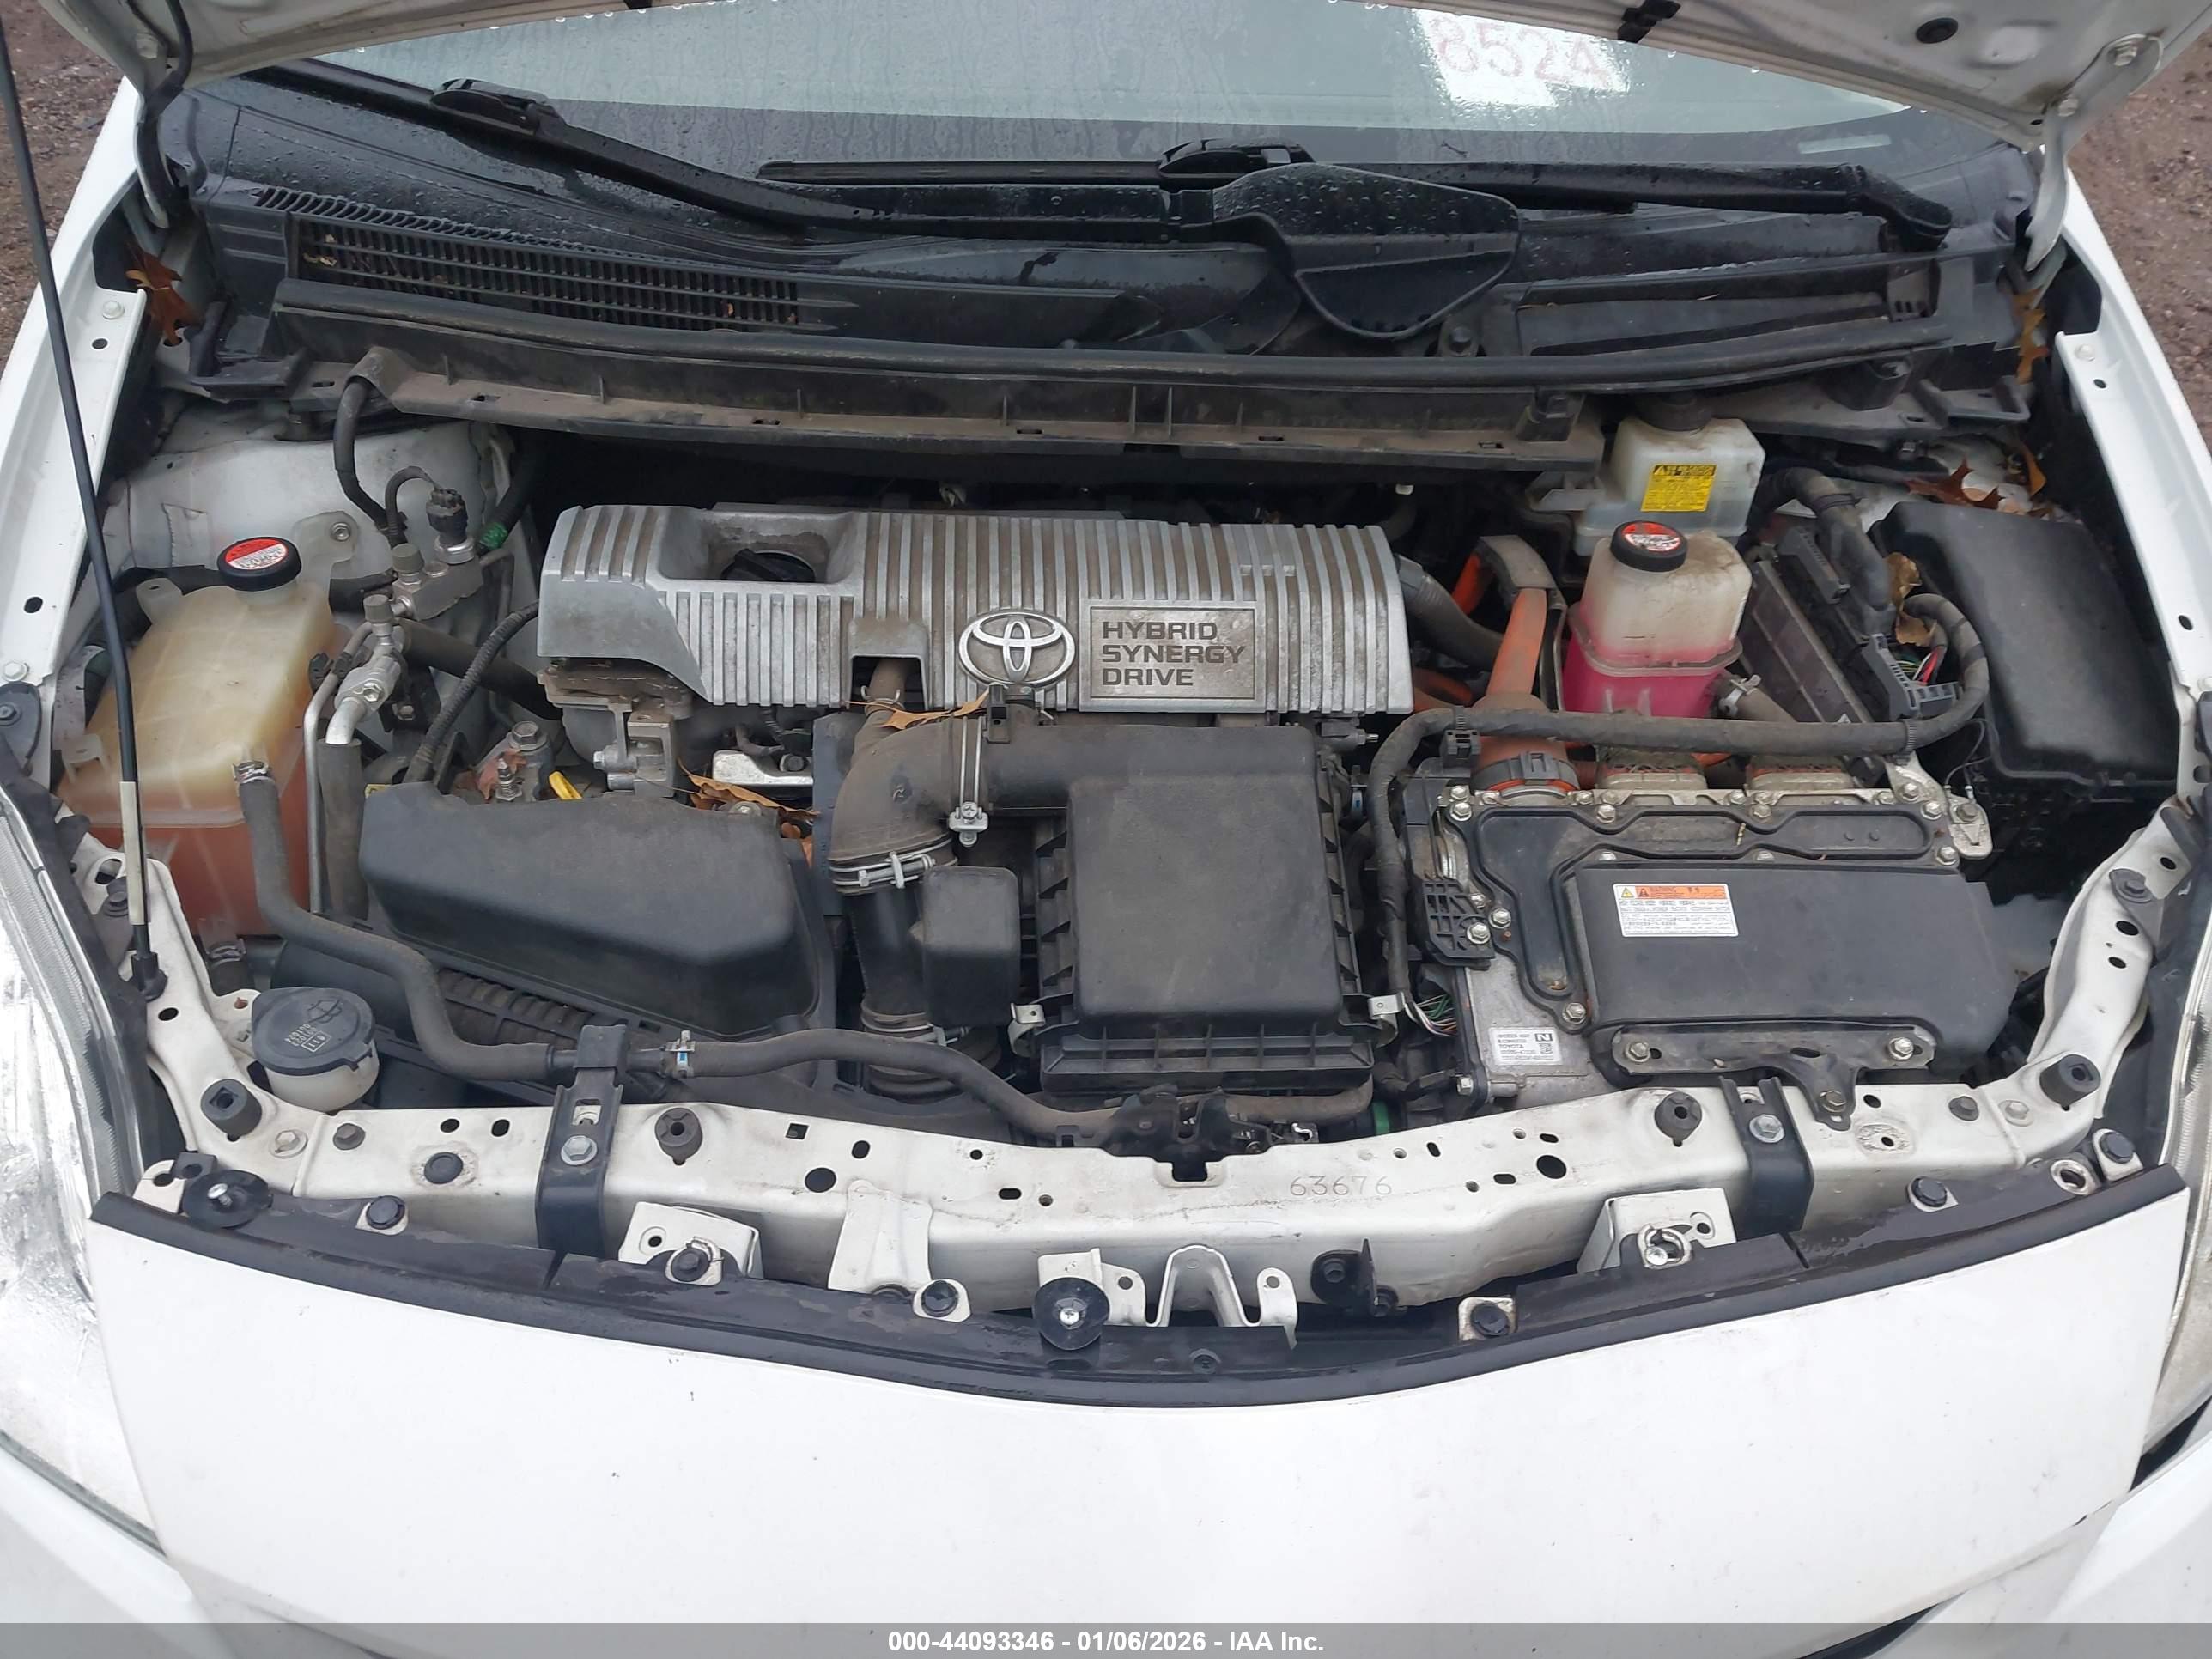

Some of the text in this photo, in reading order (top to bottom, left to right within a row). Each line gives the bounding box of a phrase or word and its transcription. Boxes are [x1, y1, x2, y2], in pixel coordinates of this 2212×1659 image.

[1103, 621, 1218, 640] HYBRID
[1102, 644, 1245, 664] SYNERGY
[1103, 667, 1194, 686] DRIVE
[1290, 1176, 1392, 1196] 63676
